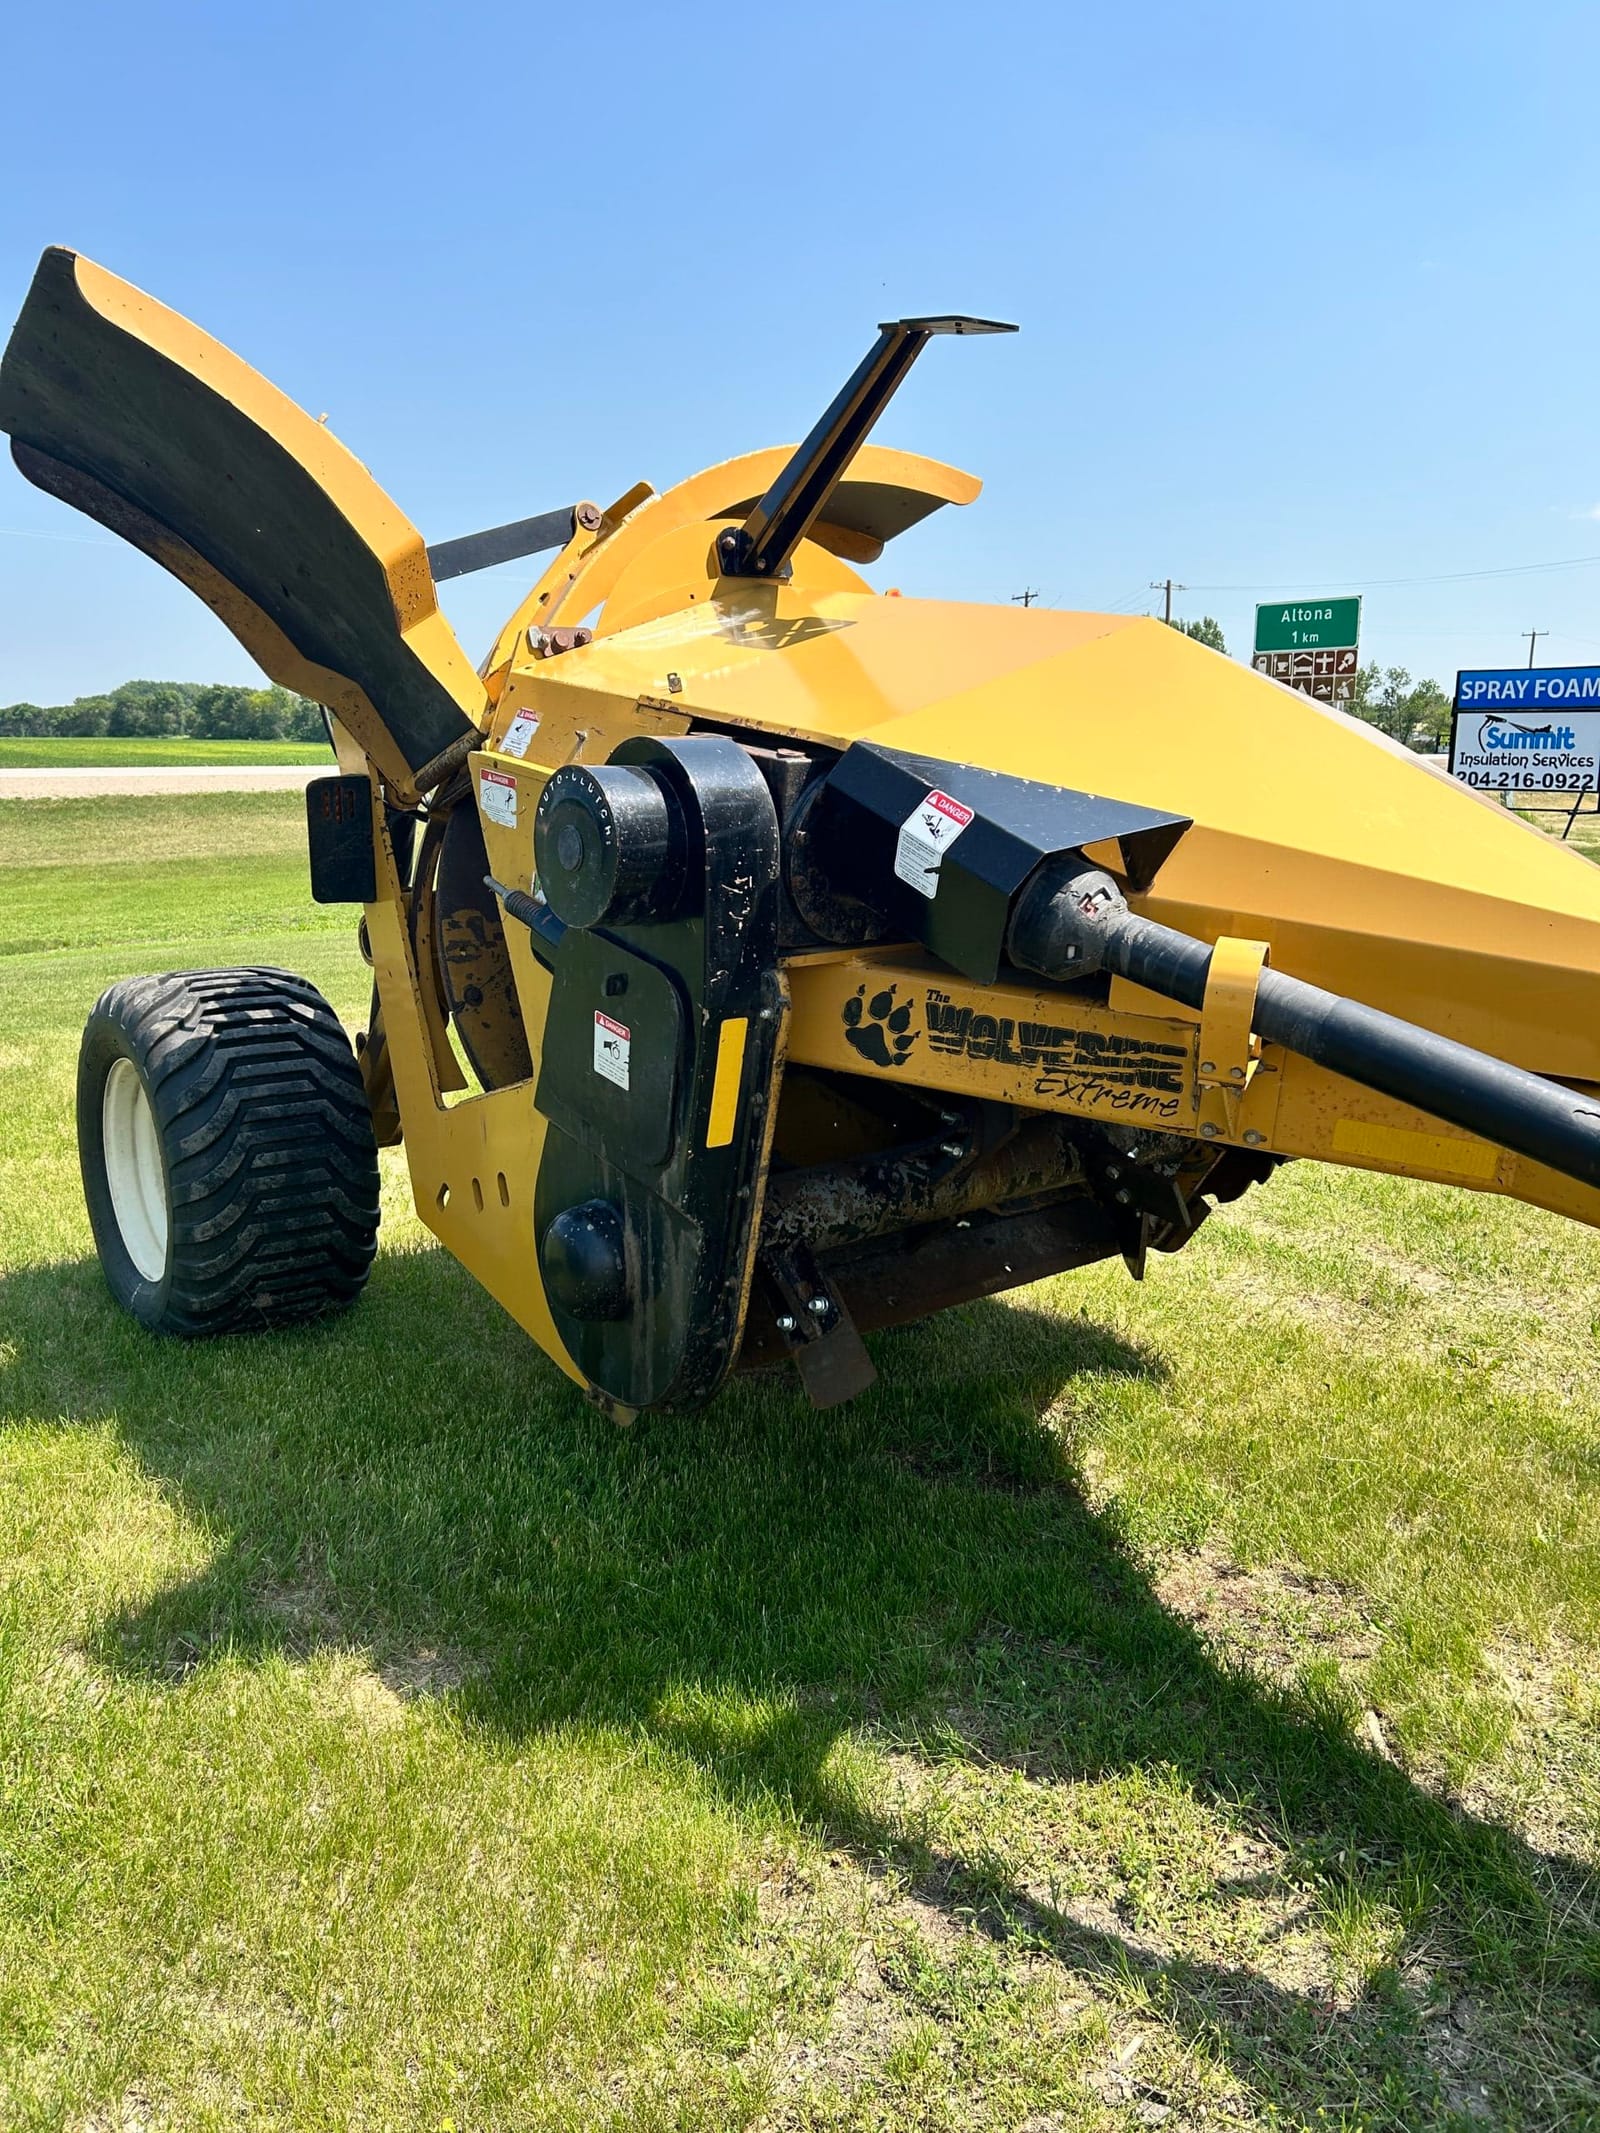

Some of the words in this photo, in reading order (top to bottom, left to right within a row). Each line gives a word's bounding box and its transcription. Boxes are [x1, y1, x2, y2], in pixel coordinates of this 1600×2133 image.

[1281, 608, 1333, 623] Altona
[1292, 630, 1298, 644] 1
[1302, 632, 1319, 643] km
[1460, 679, 1530, 700] SPRAY
[1534, 677, 1600, 699] FOAM
[1486, 726, 1576, 750] Summit
[1459, 751, 1528, 769] Insulation
[938, 799, 971, 822] DANGER
[926, 988, 951, 1004] The
[605, 1019, 626, 1038] DANGER
[925, 1001, 1188, 1093] WOLVERINE
[1034, 1076, 1179, 1117] Extreme
